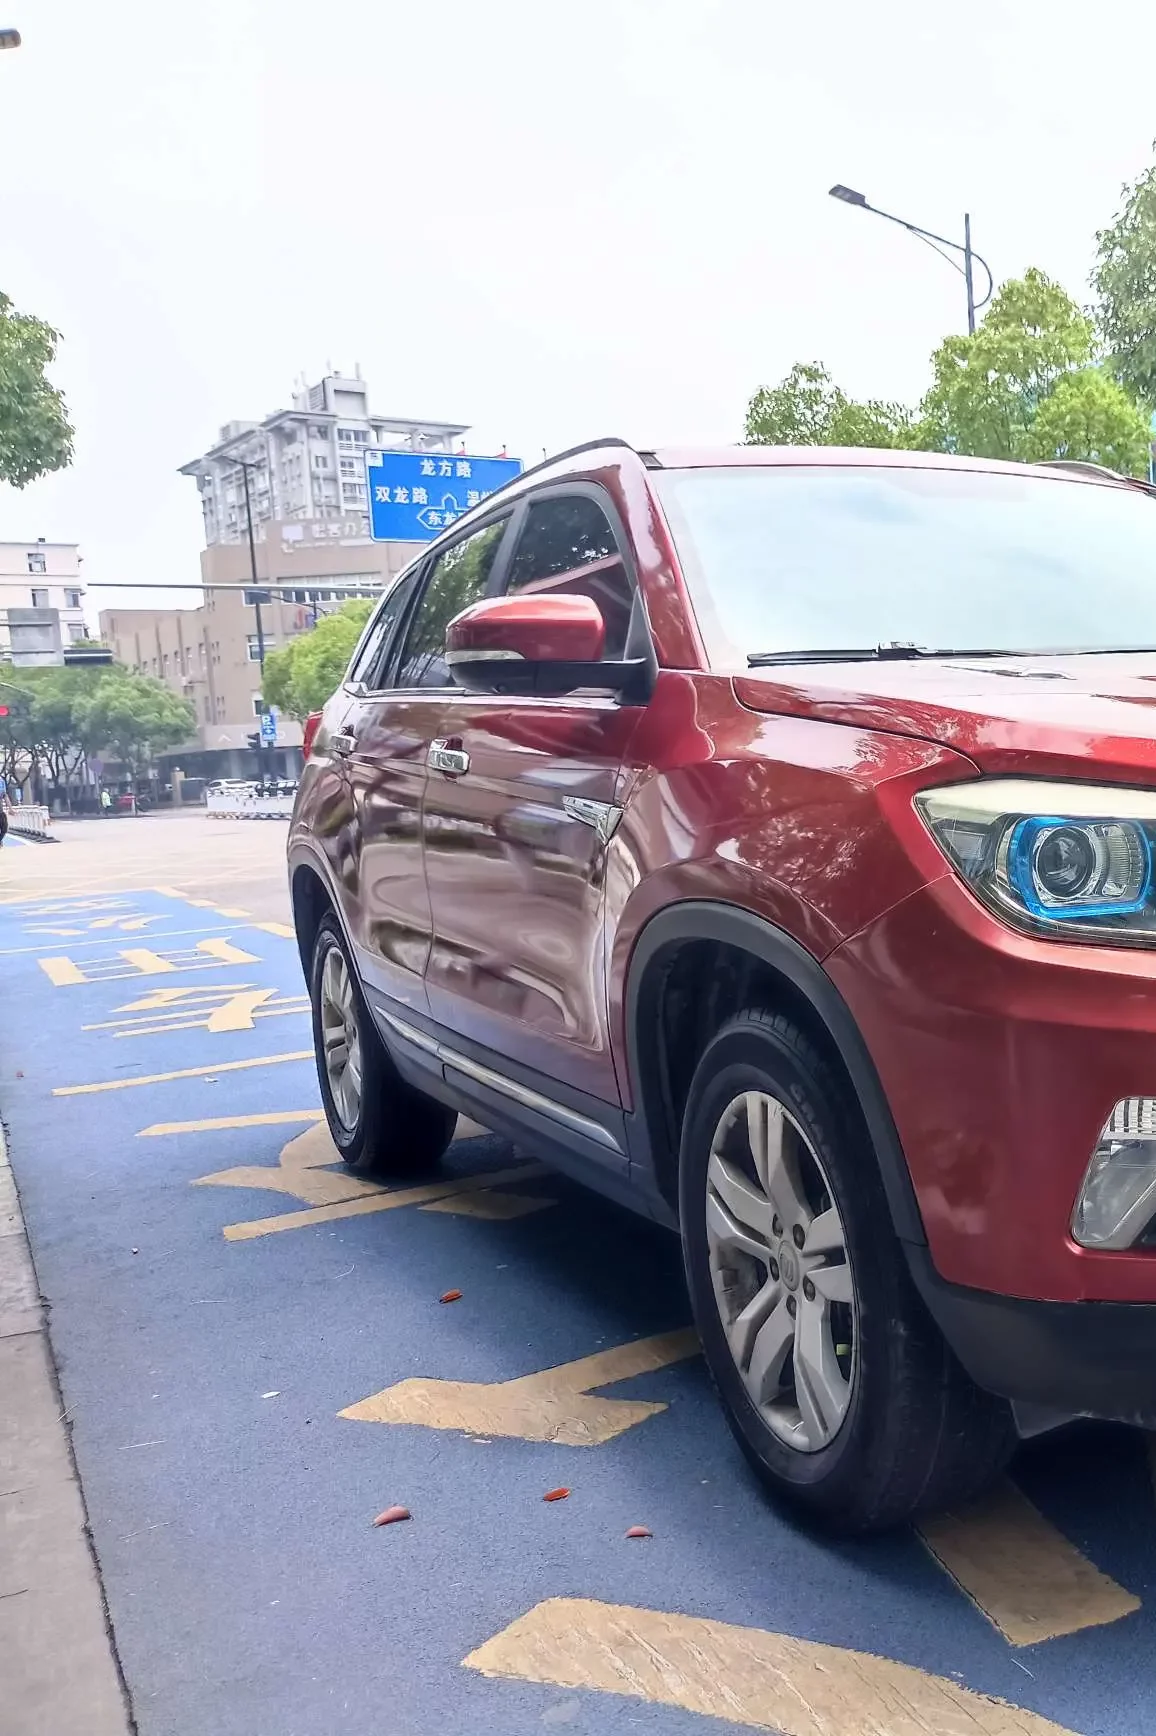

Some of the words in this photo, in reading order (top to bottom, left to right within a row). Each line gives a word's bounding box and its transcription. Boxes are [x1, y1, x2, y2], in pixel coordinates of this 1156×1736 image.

[420, 459, 472, 478] 龙方路
[375, 485, 428, 505] 双龙路
[427, 511, 464, 526] 东龙
